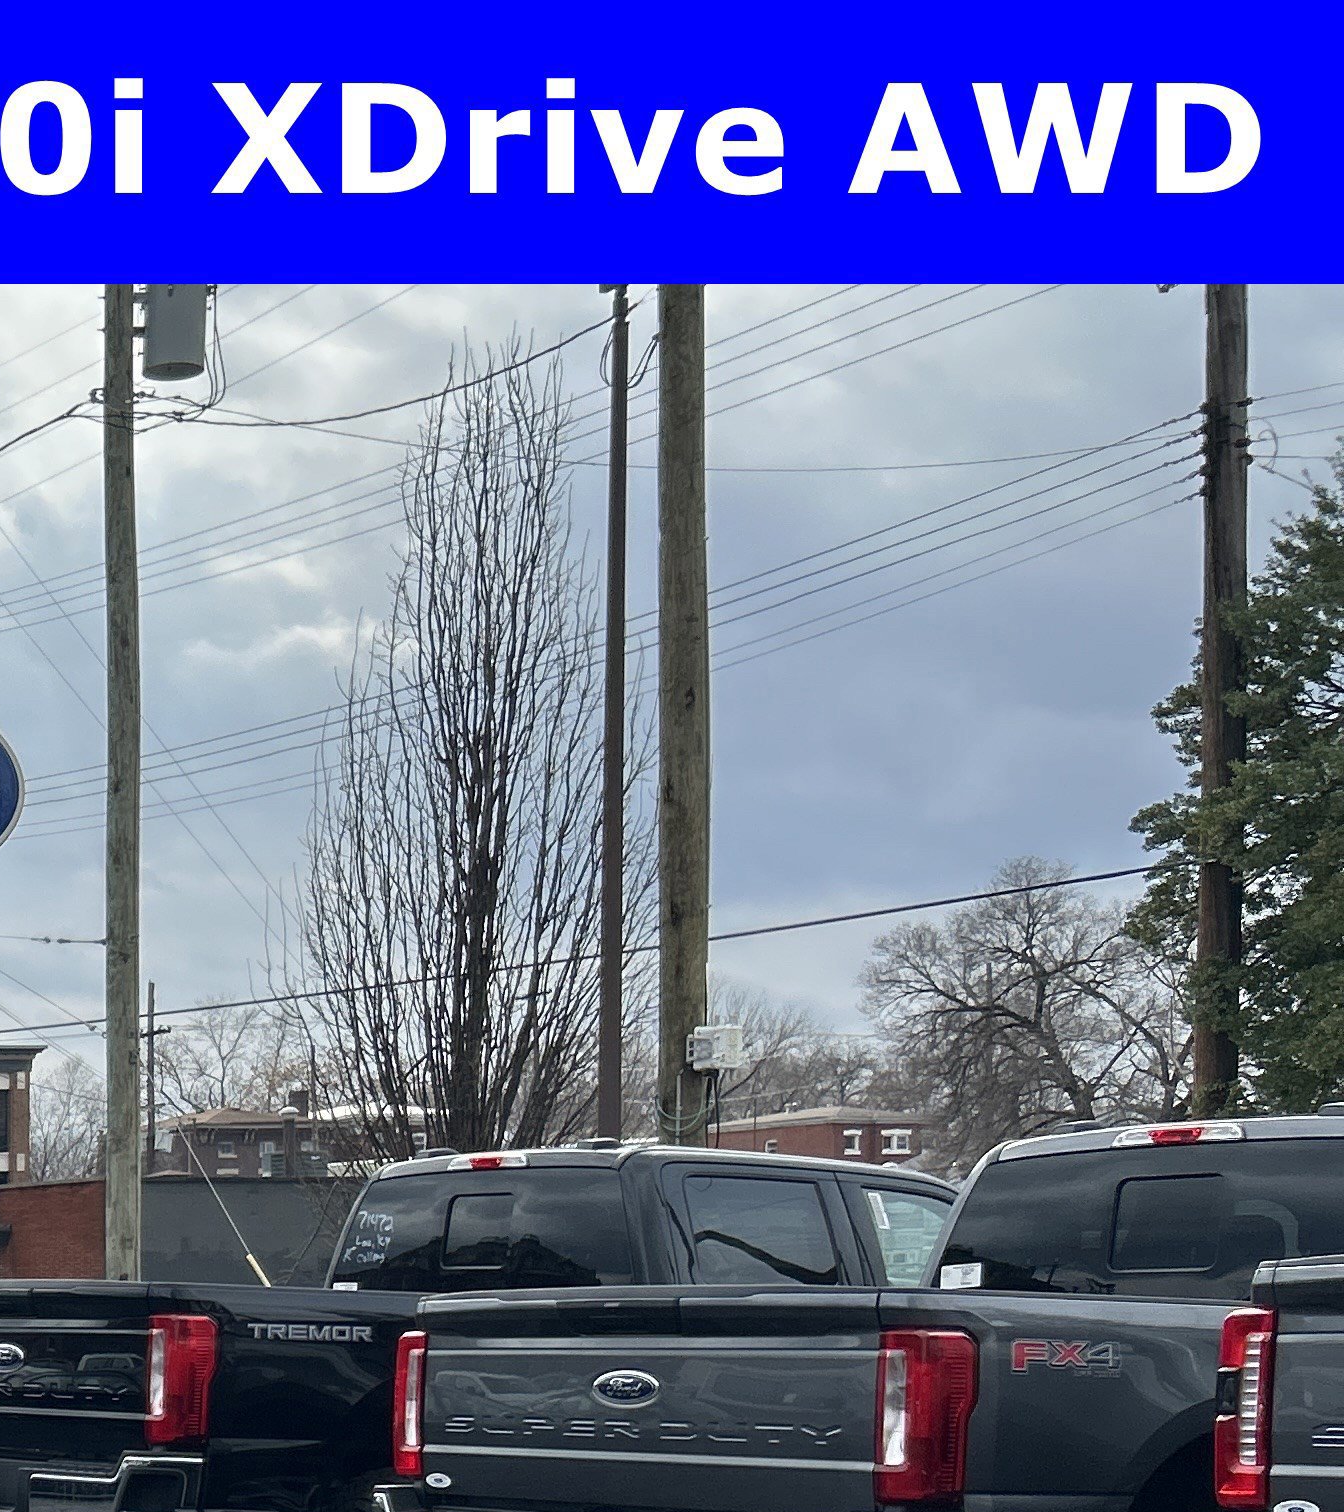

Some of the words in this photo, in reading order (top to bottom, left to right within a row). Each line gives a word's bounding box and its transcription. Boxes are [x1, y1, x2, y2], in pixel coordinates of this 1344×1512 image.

[247, 1323, 373, 1342] TREMOR
[1012, 1339, 1121, 1374] FX4
[445, 1415, 640, 1439] SUPER
[659, 1421, 843, 1445] DUTY
